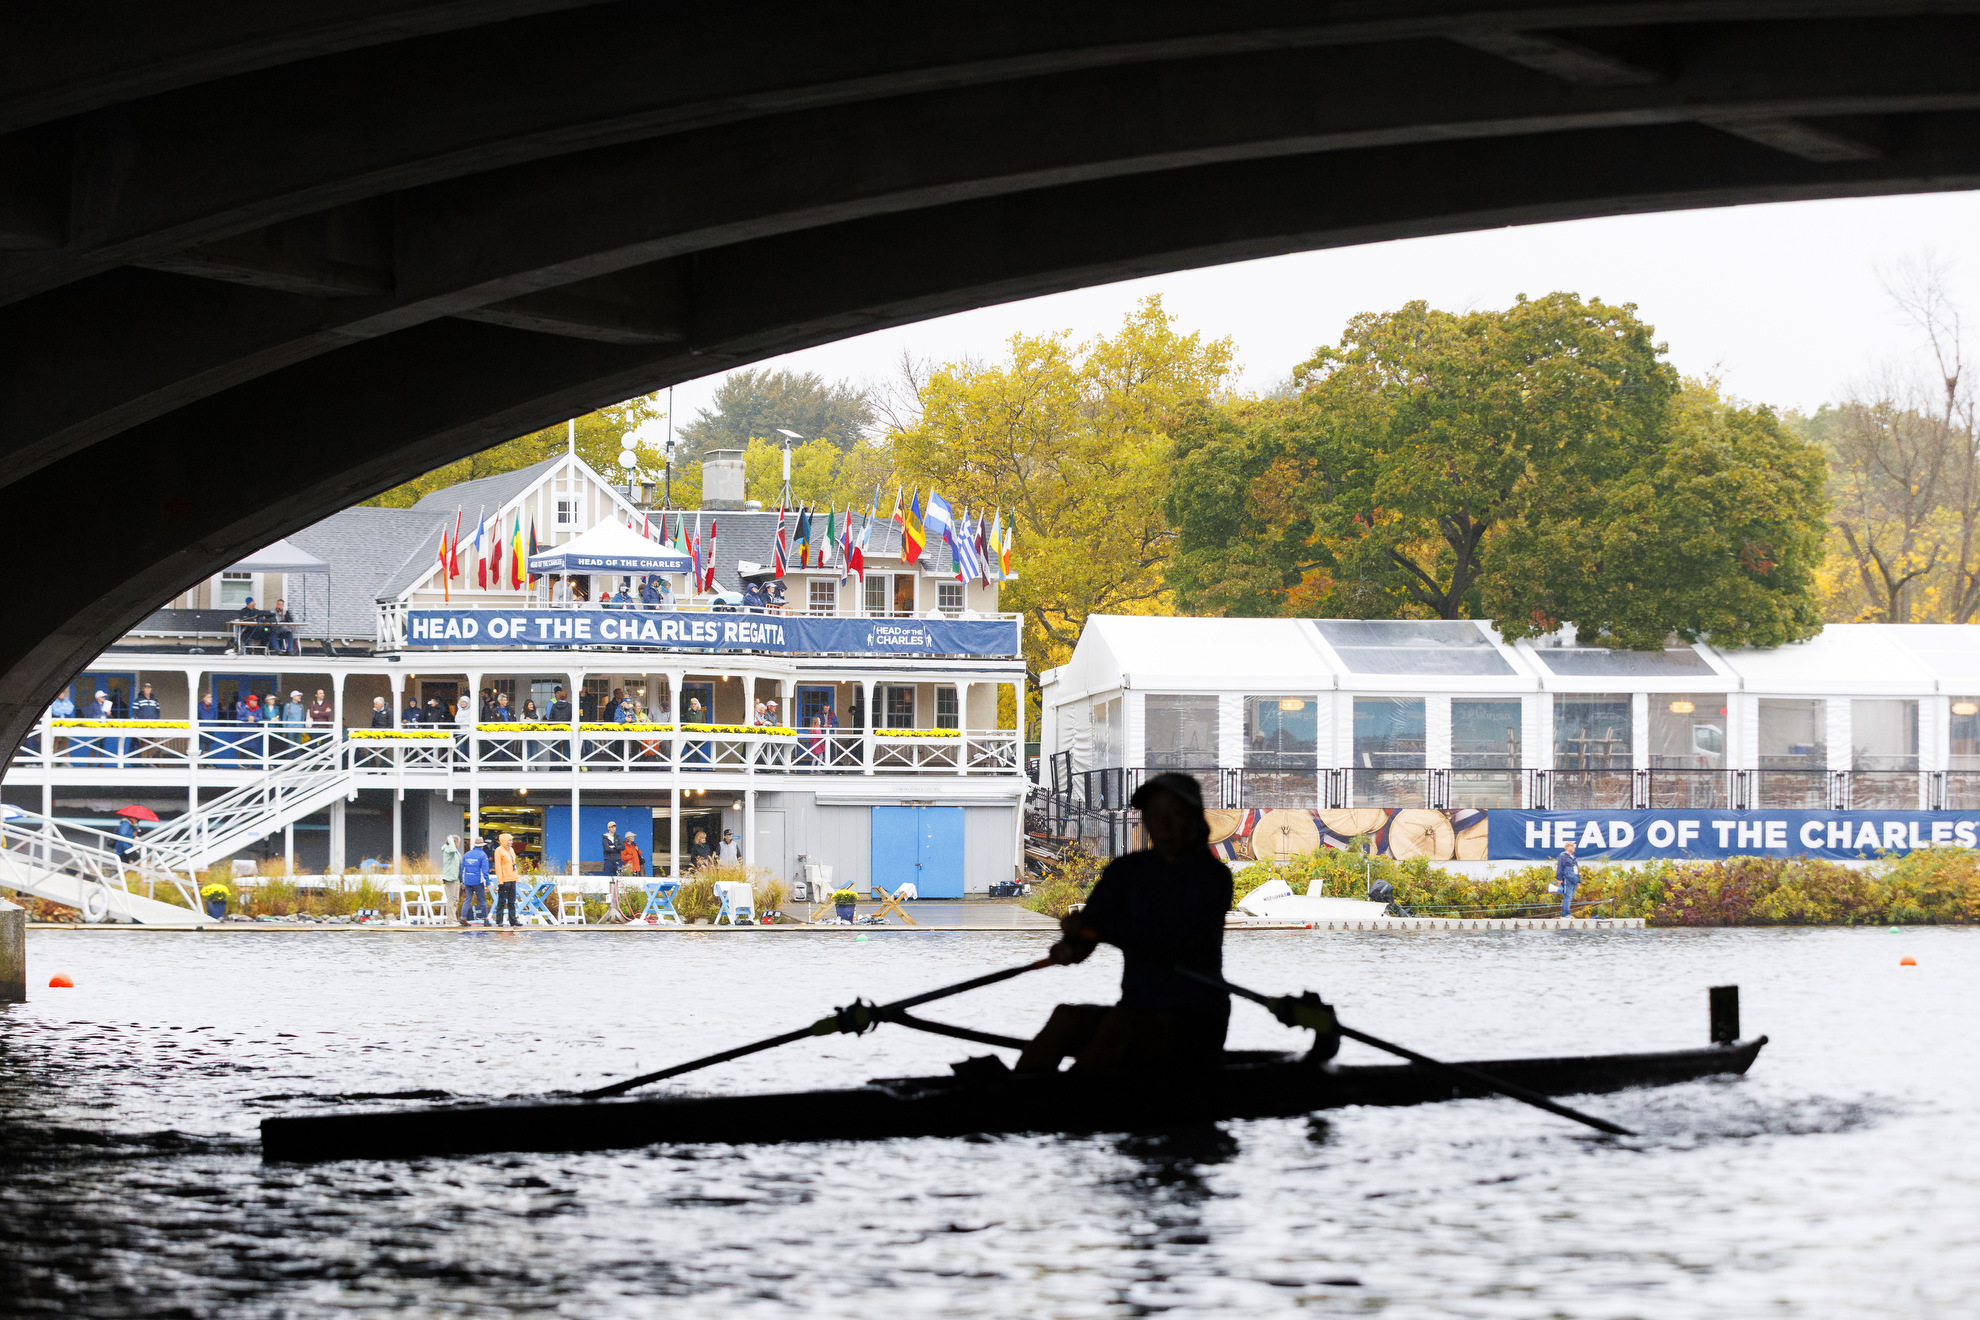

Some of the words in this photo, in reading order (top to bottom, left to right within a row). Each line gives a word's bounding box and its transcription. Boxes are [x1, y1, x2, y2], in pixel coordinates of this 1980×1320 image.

[578, 558, 603, 566] HEAD
[605, 559, 618, 567] OF
[620, 559, 638, 567] THE
[640, 560, 681, 568] CHARLES
[412, 617, 479, 639] HEAD
[487, 617, 527, 639] OF
[535, 617, 591, 640] THE
[600, 618, 718, 642] CHARLES
[724, 619, 785, 646] REGATTA
[876, 627, 901, 635] HEAD
[876, 636, 924, 645] CHARLES
[1525, 820, 1635, 849] HEAD
[1647, 819, 1700, 849] OF
[1712, 820, 1788, 849] THE
[1799, 820, 1978, 850] CHARLES
